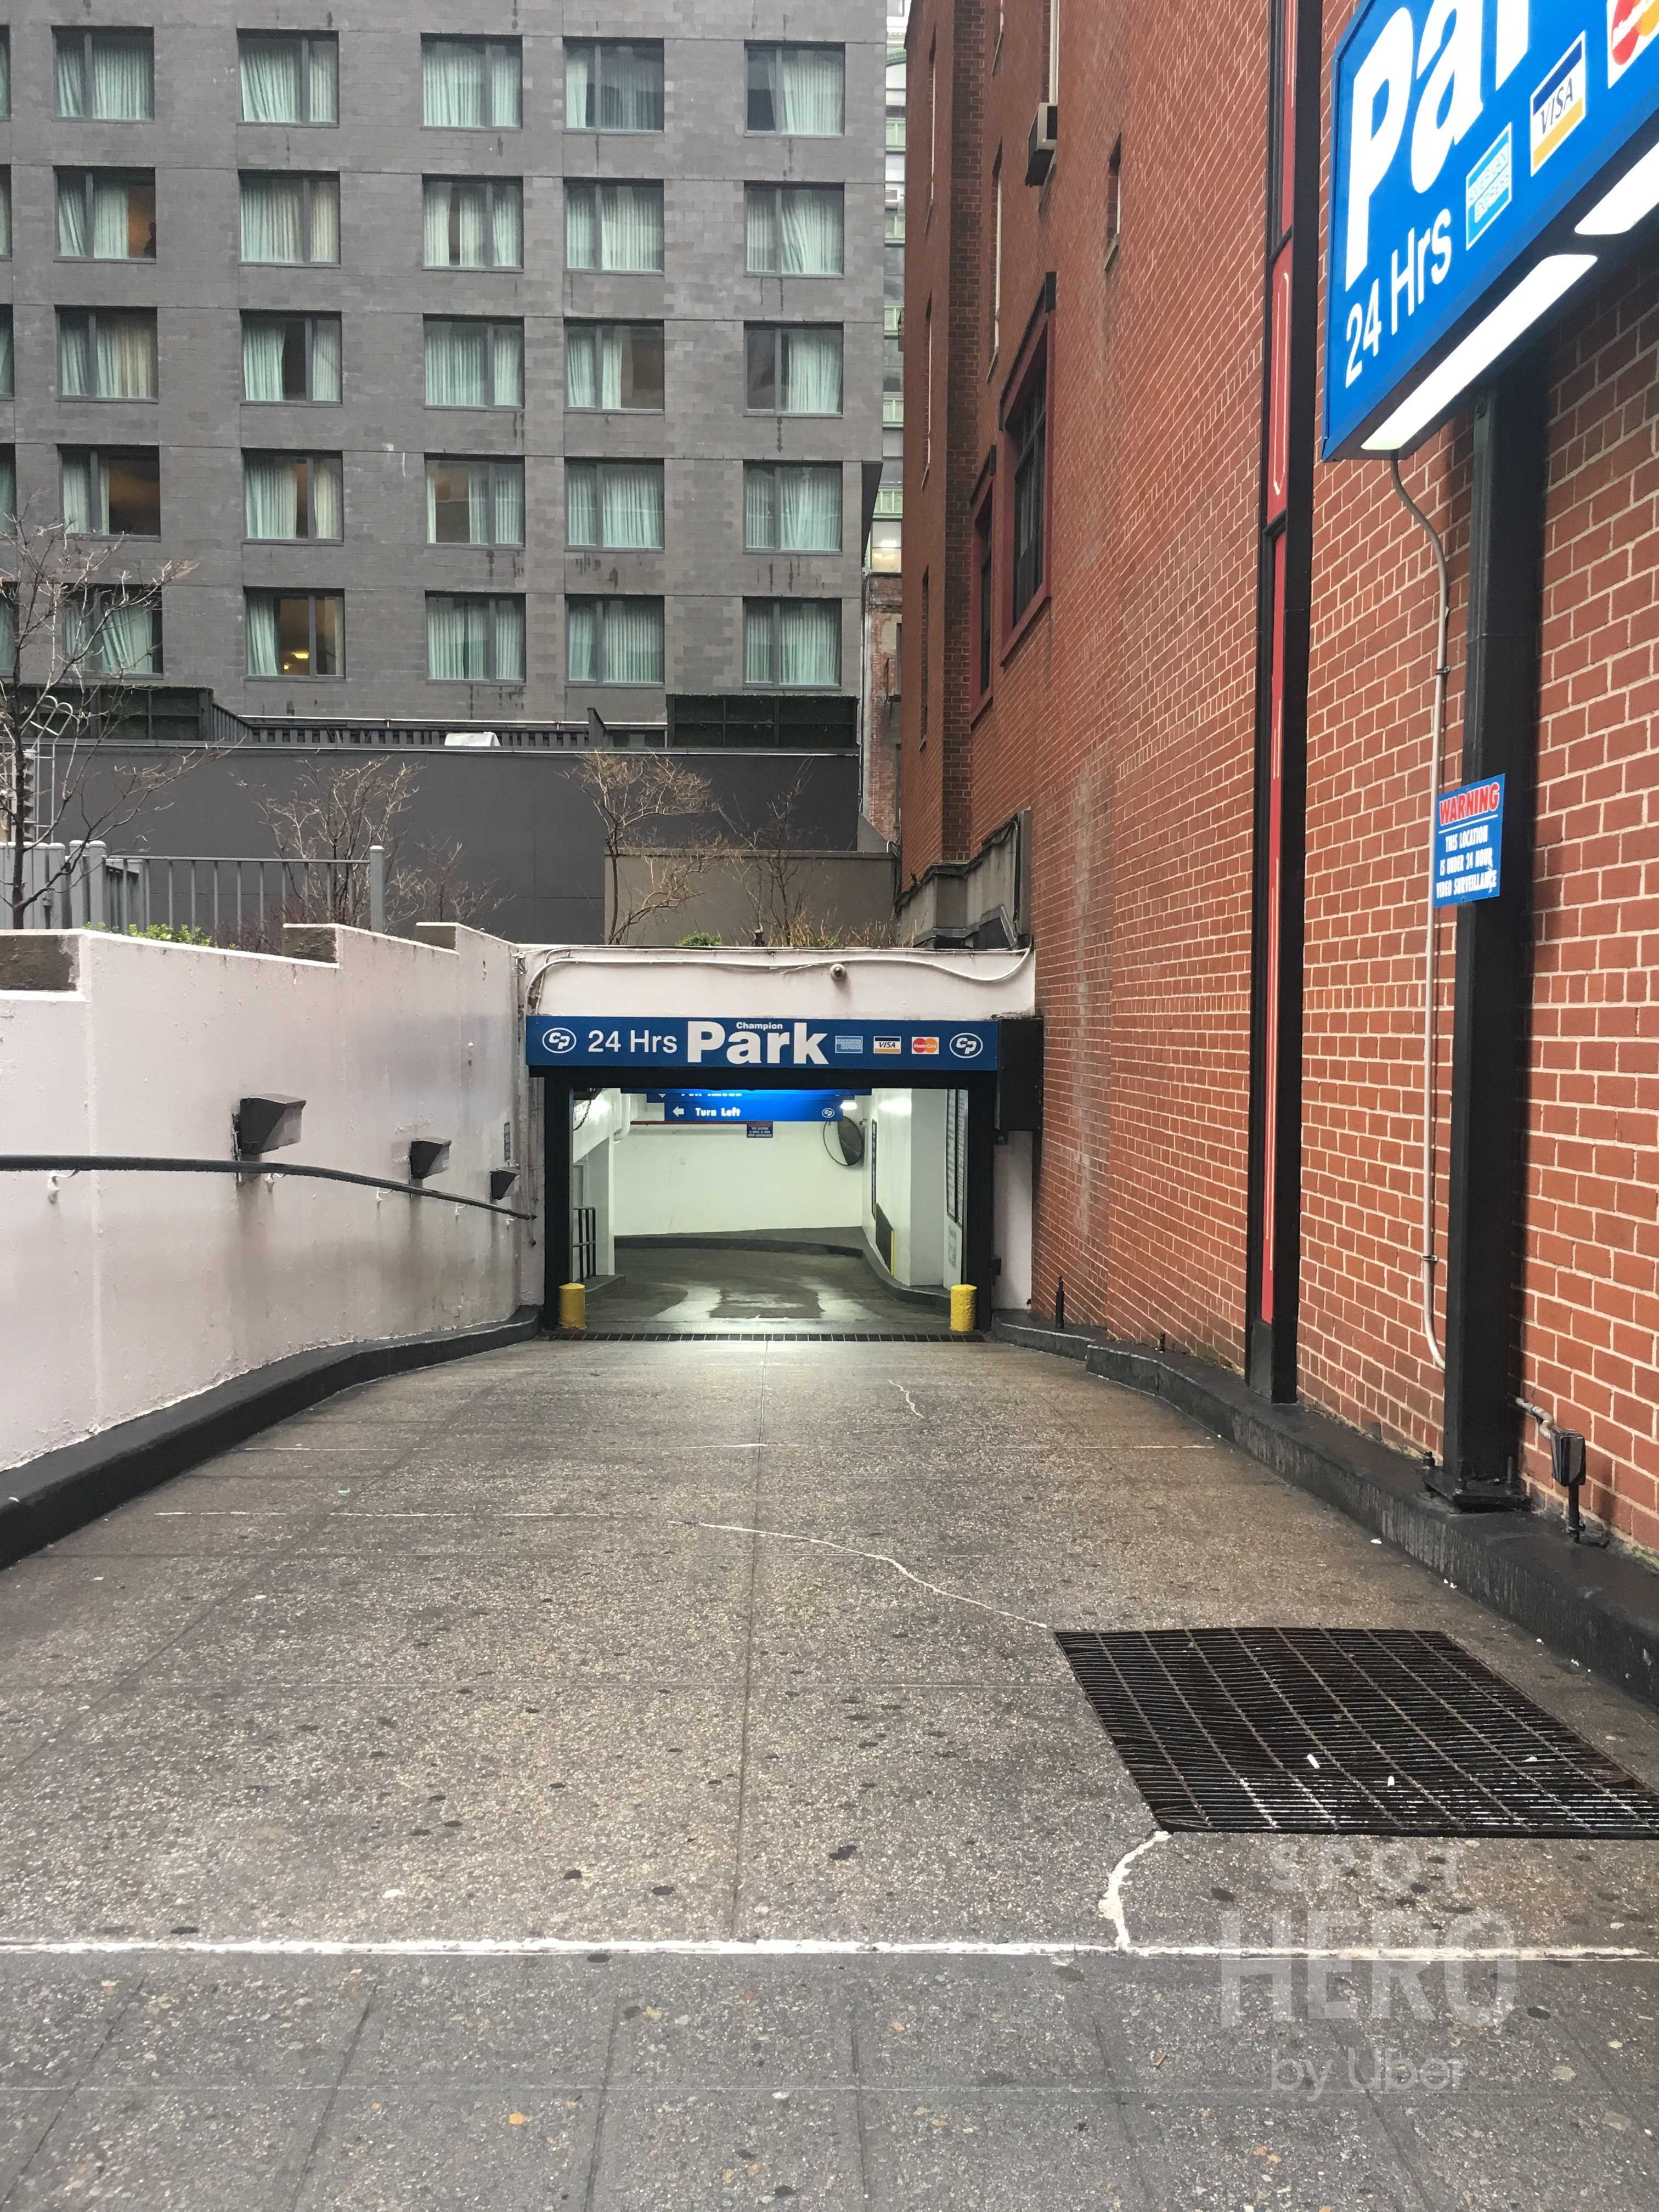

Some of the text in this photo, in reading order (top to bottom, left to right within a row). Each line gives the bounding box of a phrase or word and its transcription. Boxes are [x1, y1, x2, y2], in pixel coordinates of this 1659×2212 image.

[1540, 76, 1573, 135] VISA
[1345, 208, 1452, 388] 24 Hrs
[1439, 782, 1499, 826] WARNING
[1445, 825, 1489, 853] THIS LOCATION
[1440, 848, 1493, 876] IS UNDER 24 HOUR
[1436, 870, 1497, 899] VIDEO SURVEILLANCE
[736, 1021, 783, 1031] Champion
[588, 1020, 830, 1065] 24 Hrs Park
[695, 1107, 741, 1117] Turn Left
